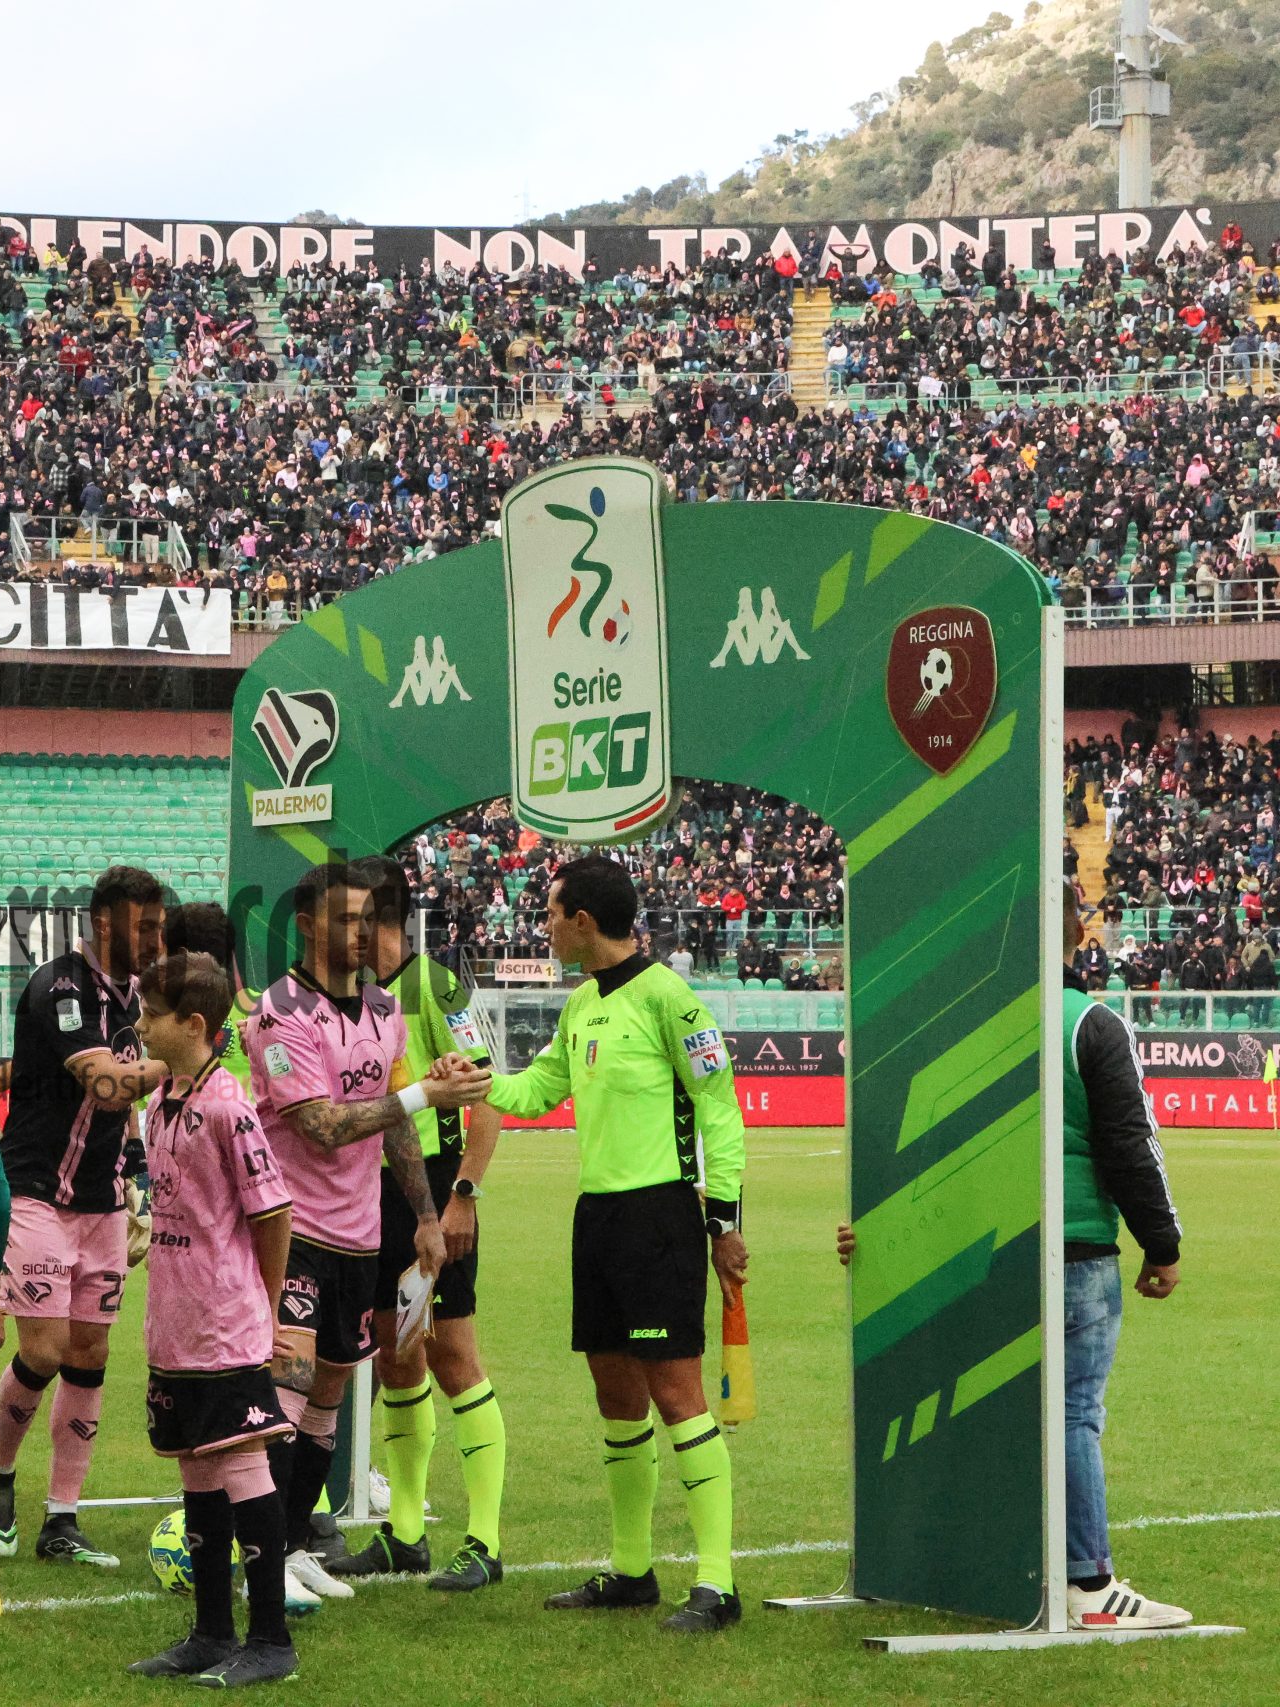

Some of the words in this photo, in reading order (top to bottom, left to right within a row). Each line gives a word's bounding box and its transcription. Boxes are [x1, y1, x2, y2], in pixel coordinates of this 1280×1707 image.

[434, 228, 586, 282] NON
[909, 620, 974, 644] REGGINA
[553, 666, 622, 709] Serie
[927, 734, 953, 748] 1914
[531, 724, 648, 787] BKT
[255, 793, 328, 817] PALERMO
[496, 963, 543, 974] USCITA
[587, 1016, 609, 1026] LEGEA
[683, 1029, 717, 1052] NET
[688, 1043, 722, 1059] INSURANCE
[629, 1328, 668, 1339] LEGEA
